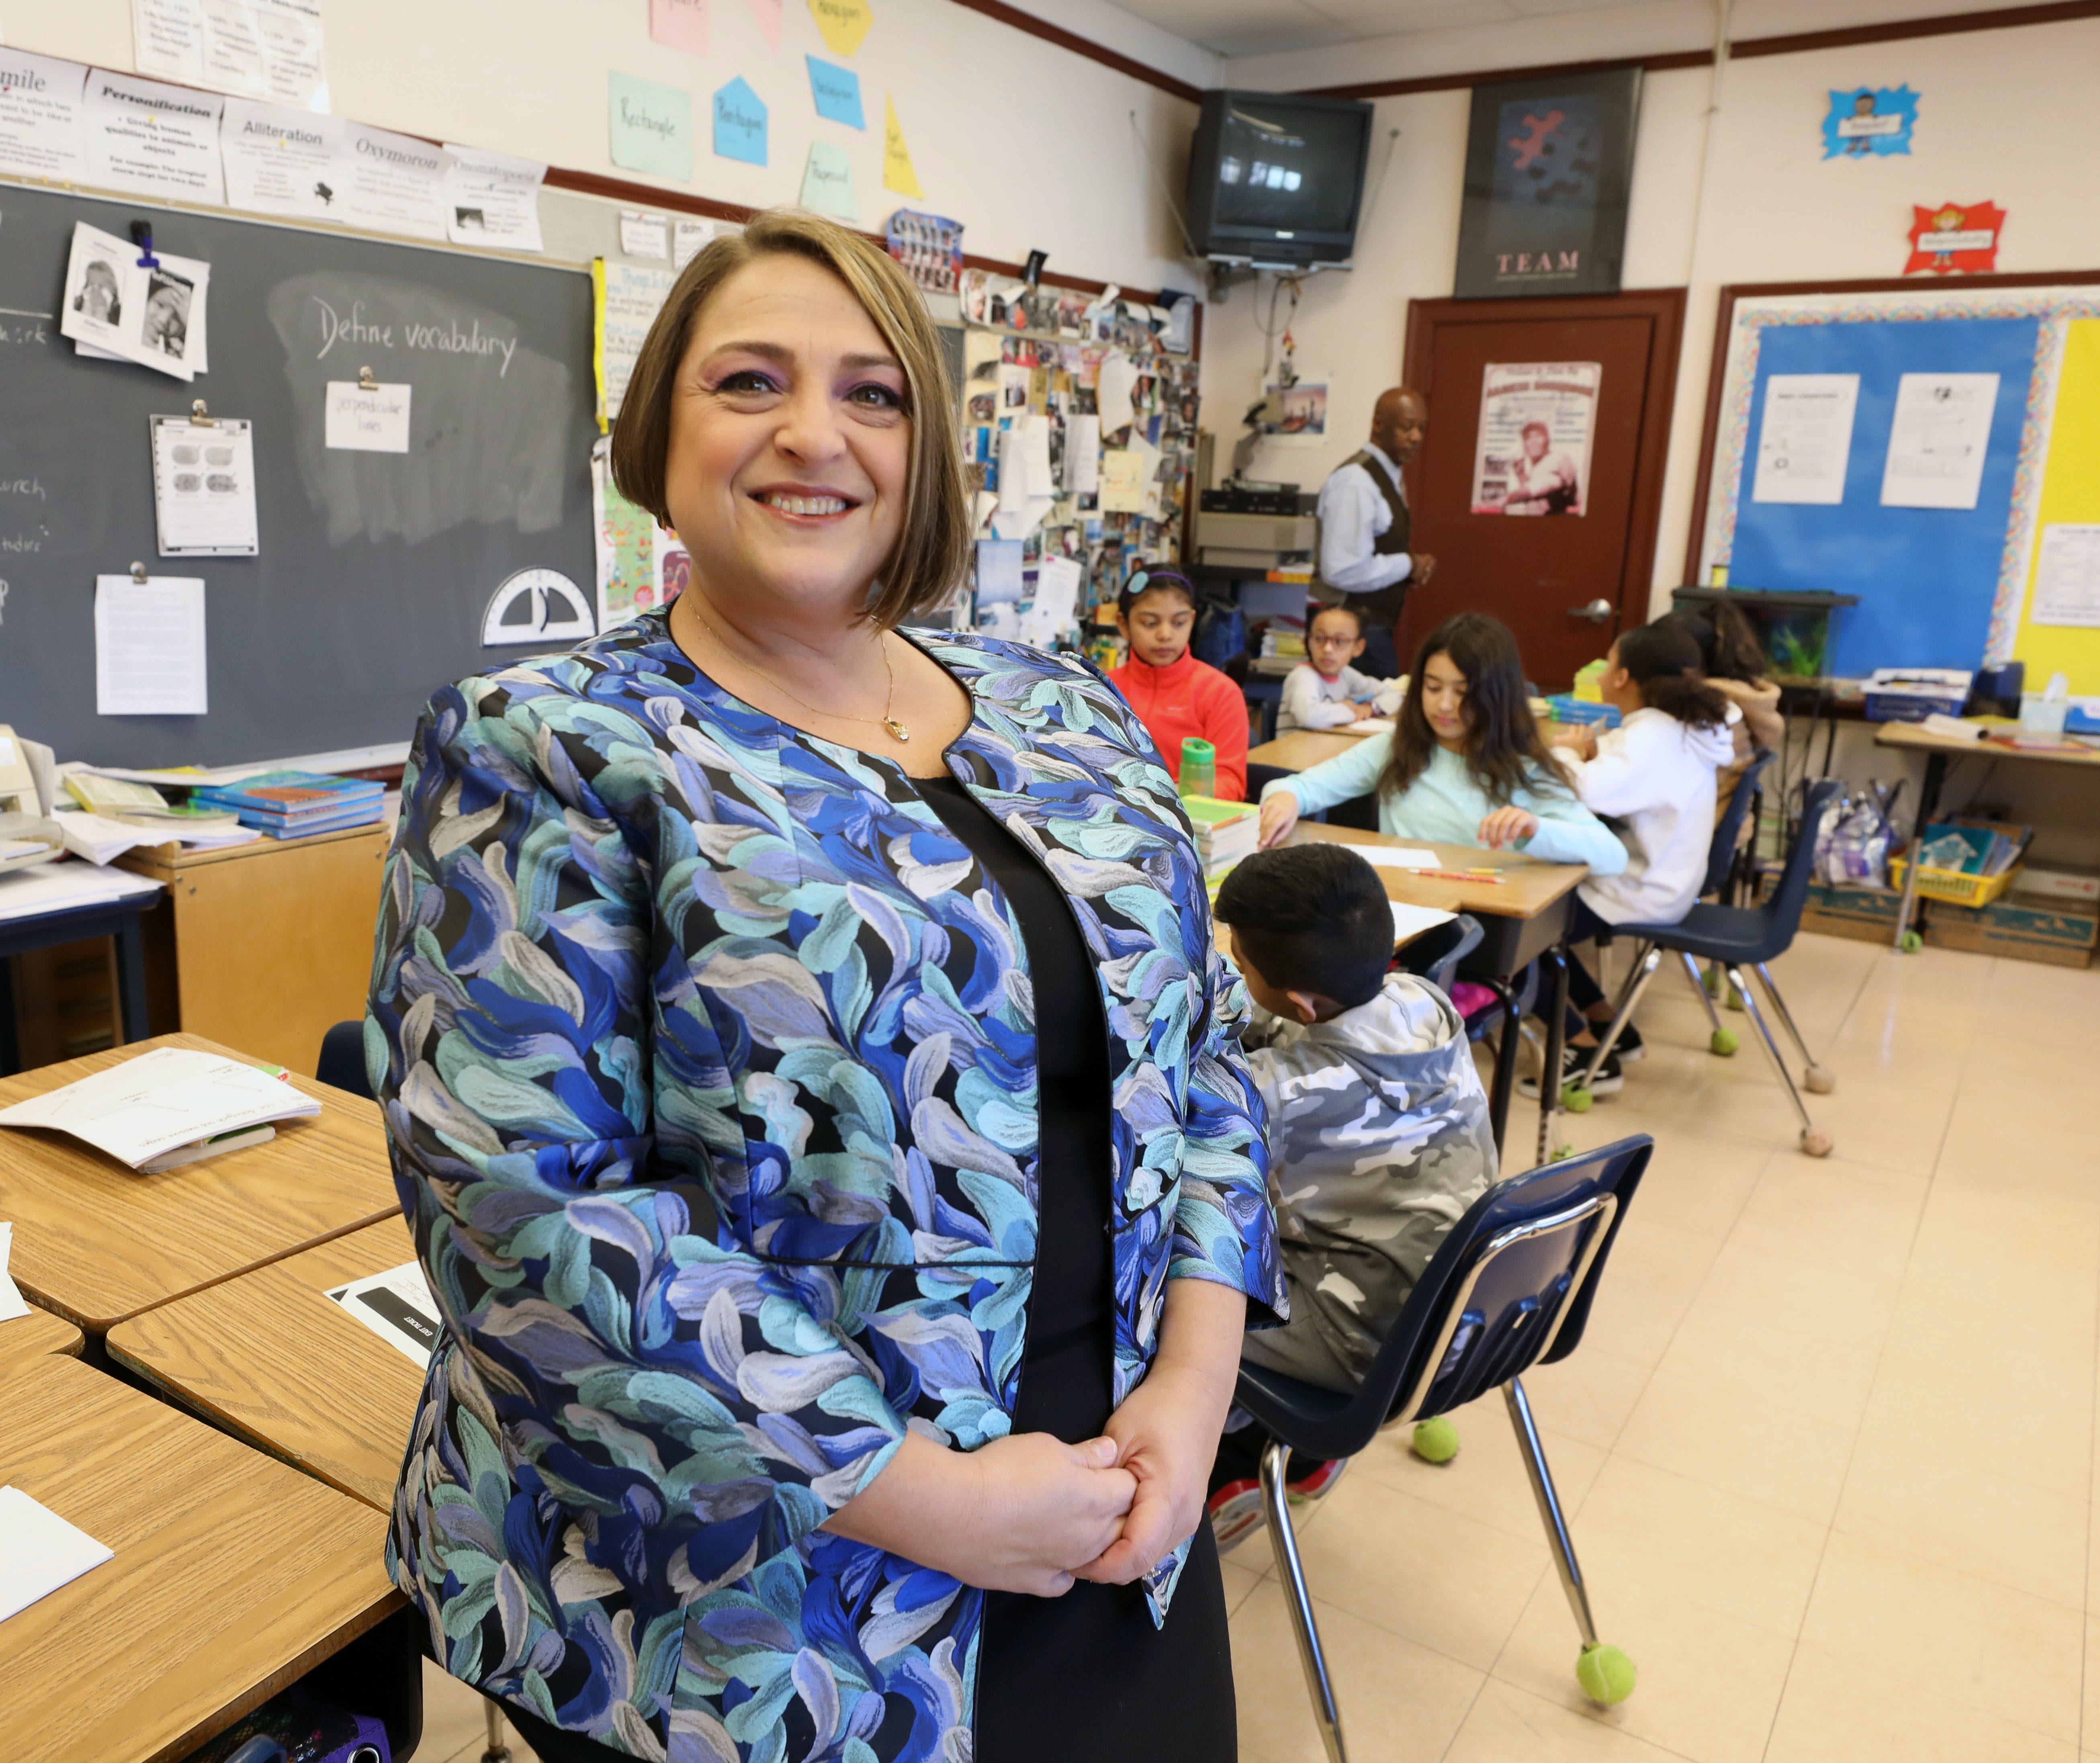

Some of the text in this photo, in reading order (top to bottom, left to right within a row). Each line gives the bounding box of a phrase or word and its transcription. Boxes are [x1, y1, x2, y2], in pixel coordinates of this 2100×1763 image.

[103, 86, 211, 118] Personification
[244, 119, 323, 145] Alliteration
[620, 96, 677, 141] Rectangle
[356, 137, 439, 170] Oxymoron
[1497, 251, 1579, 272] TEAM
[312, 296, 517, 378] Define vocabulary
[403, 1316, 433, 1336] EXIT TICKET
